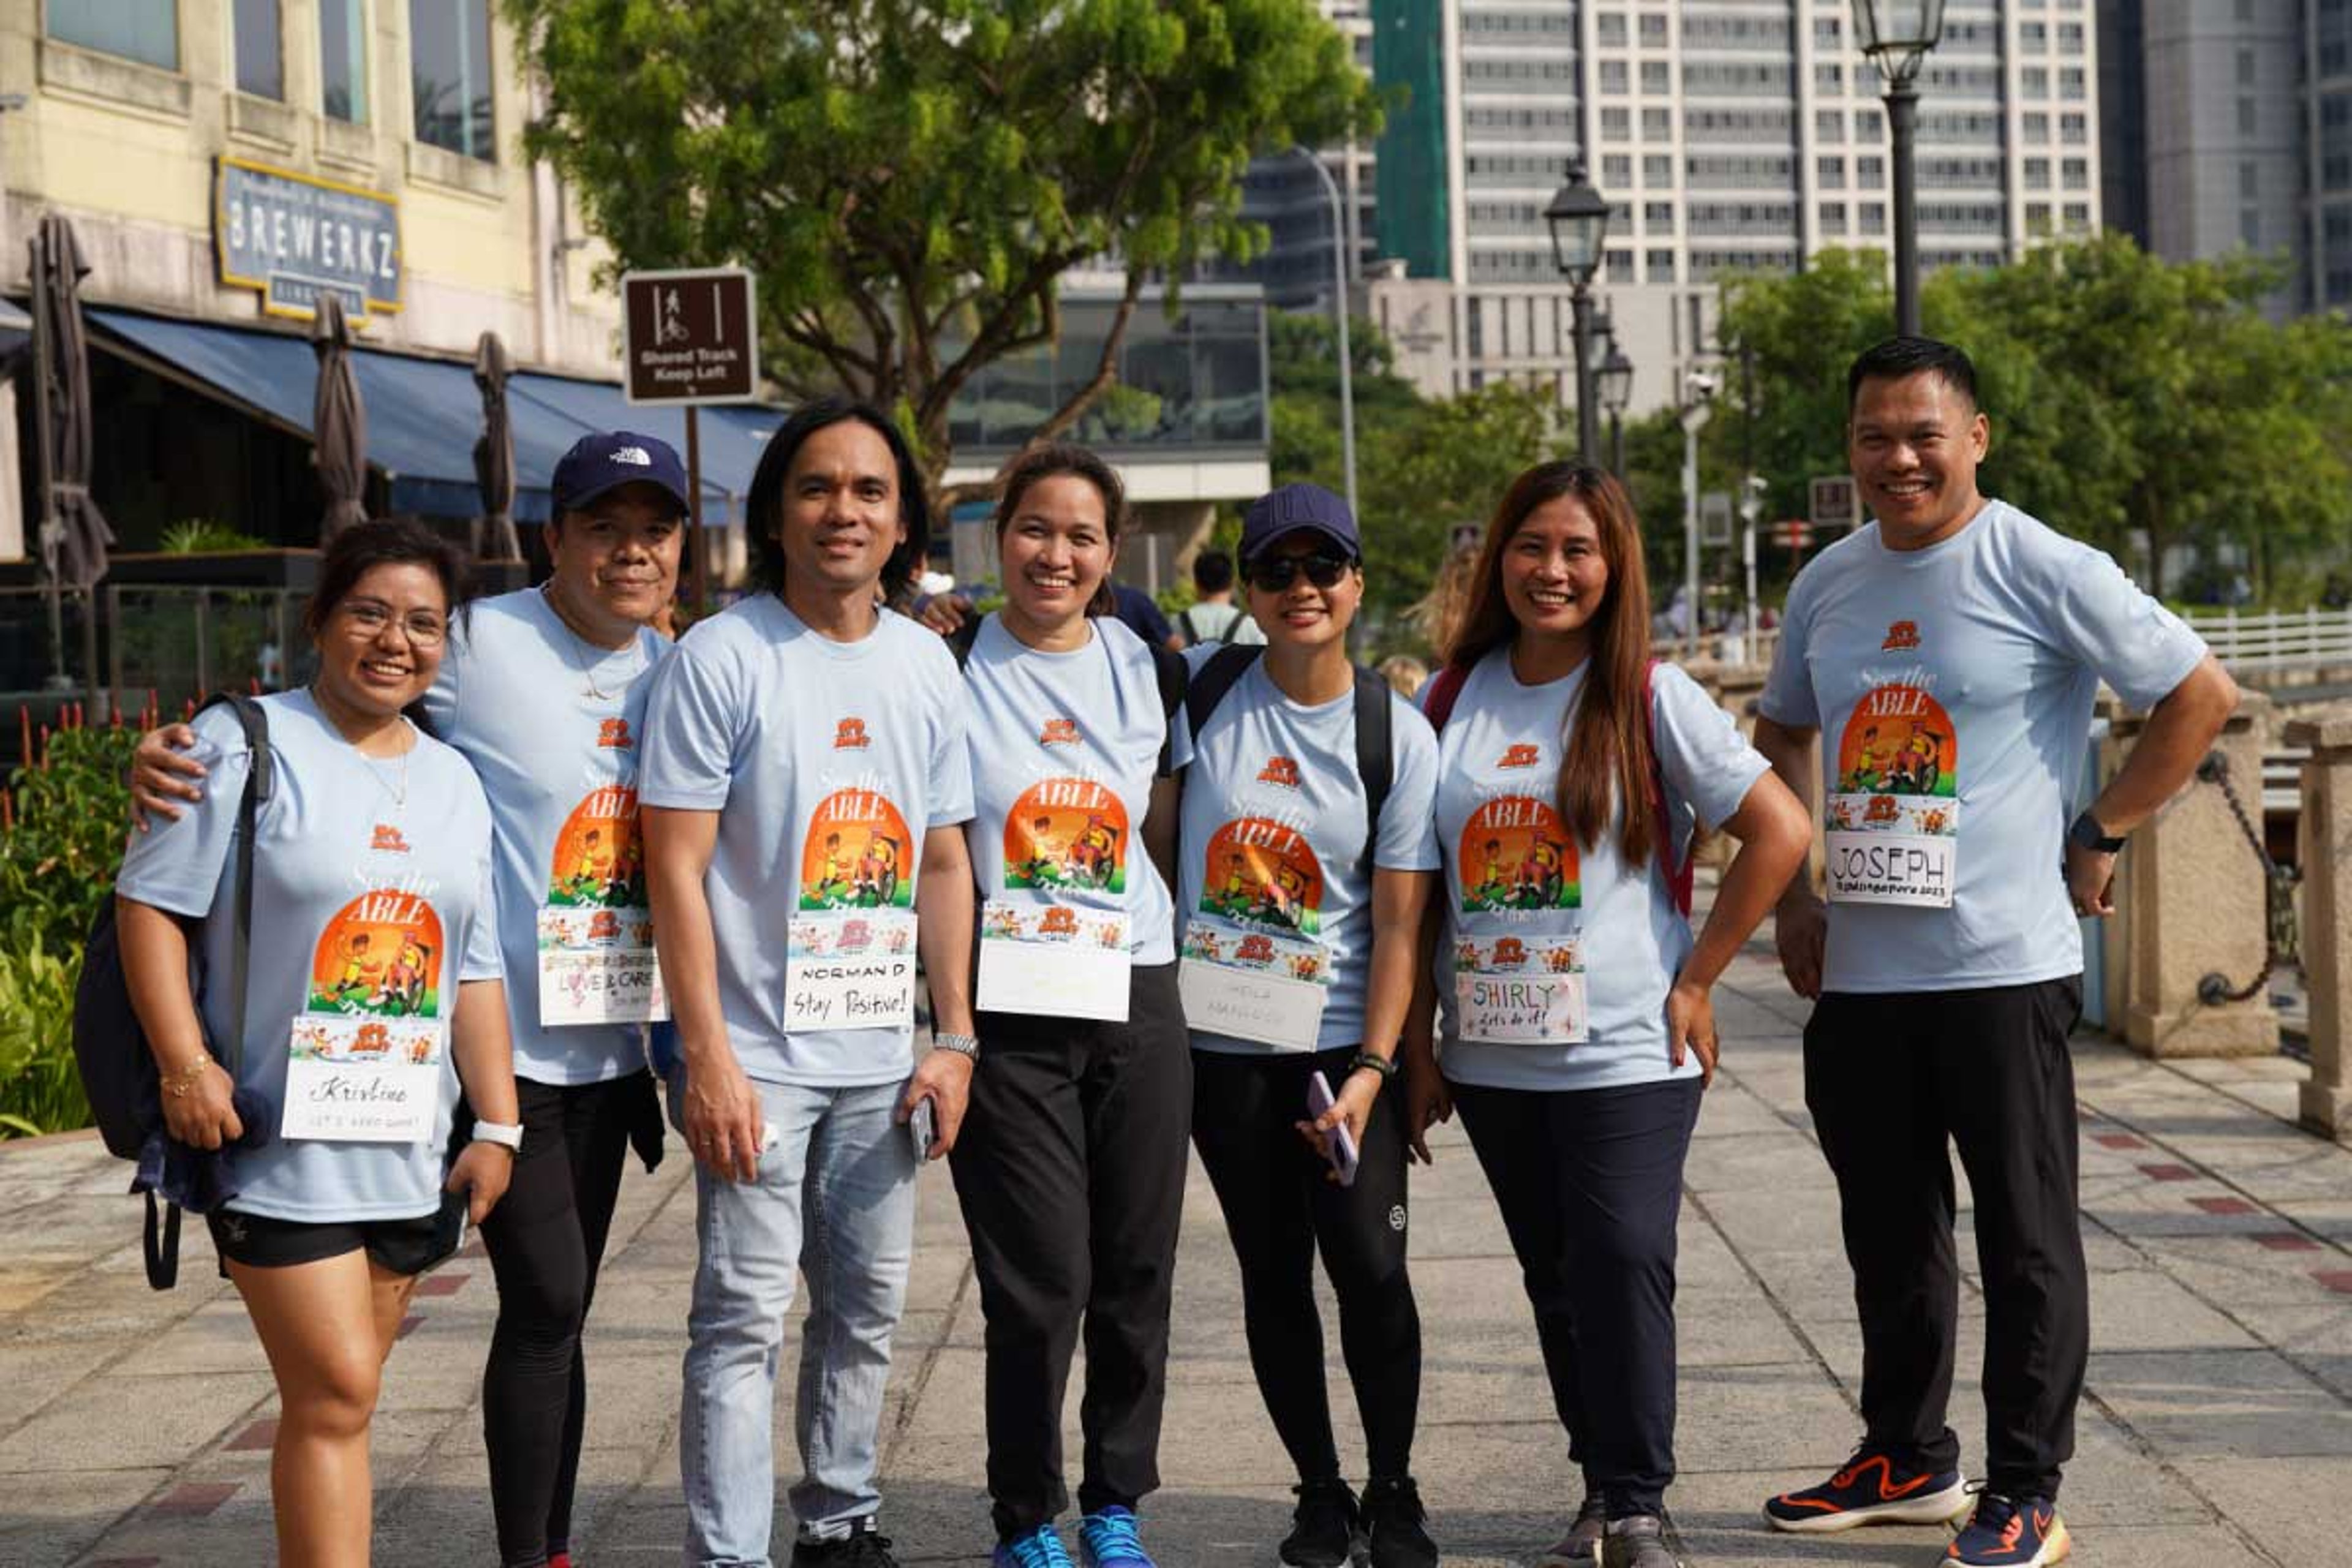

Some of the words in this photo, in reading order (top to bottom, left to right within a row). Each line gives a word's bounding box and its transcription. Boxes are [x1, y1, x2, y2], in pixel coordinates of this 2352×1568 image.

[230, 200, 396, 279] BREWERKZ
[1861, 690, 1930, 717] ABLE
[820, 794, 887, 822] ABLE
[1027, 783, 1110, 810] ABLE
[1471, 801, 1550, 829] ABLE
[1222, 818, 1301, 858] ABLE
[1833, 846, 1944, 884] JOSEPH
[347, 894, 427, 927] ABLE
[794, 992, 831, 1020] Stay
[845, 987, 907, 1017] Positive!
[1474, 981, 1555, 1009] SHIRLY
[310, 1076, 407, 1102] Kristine
